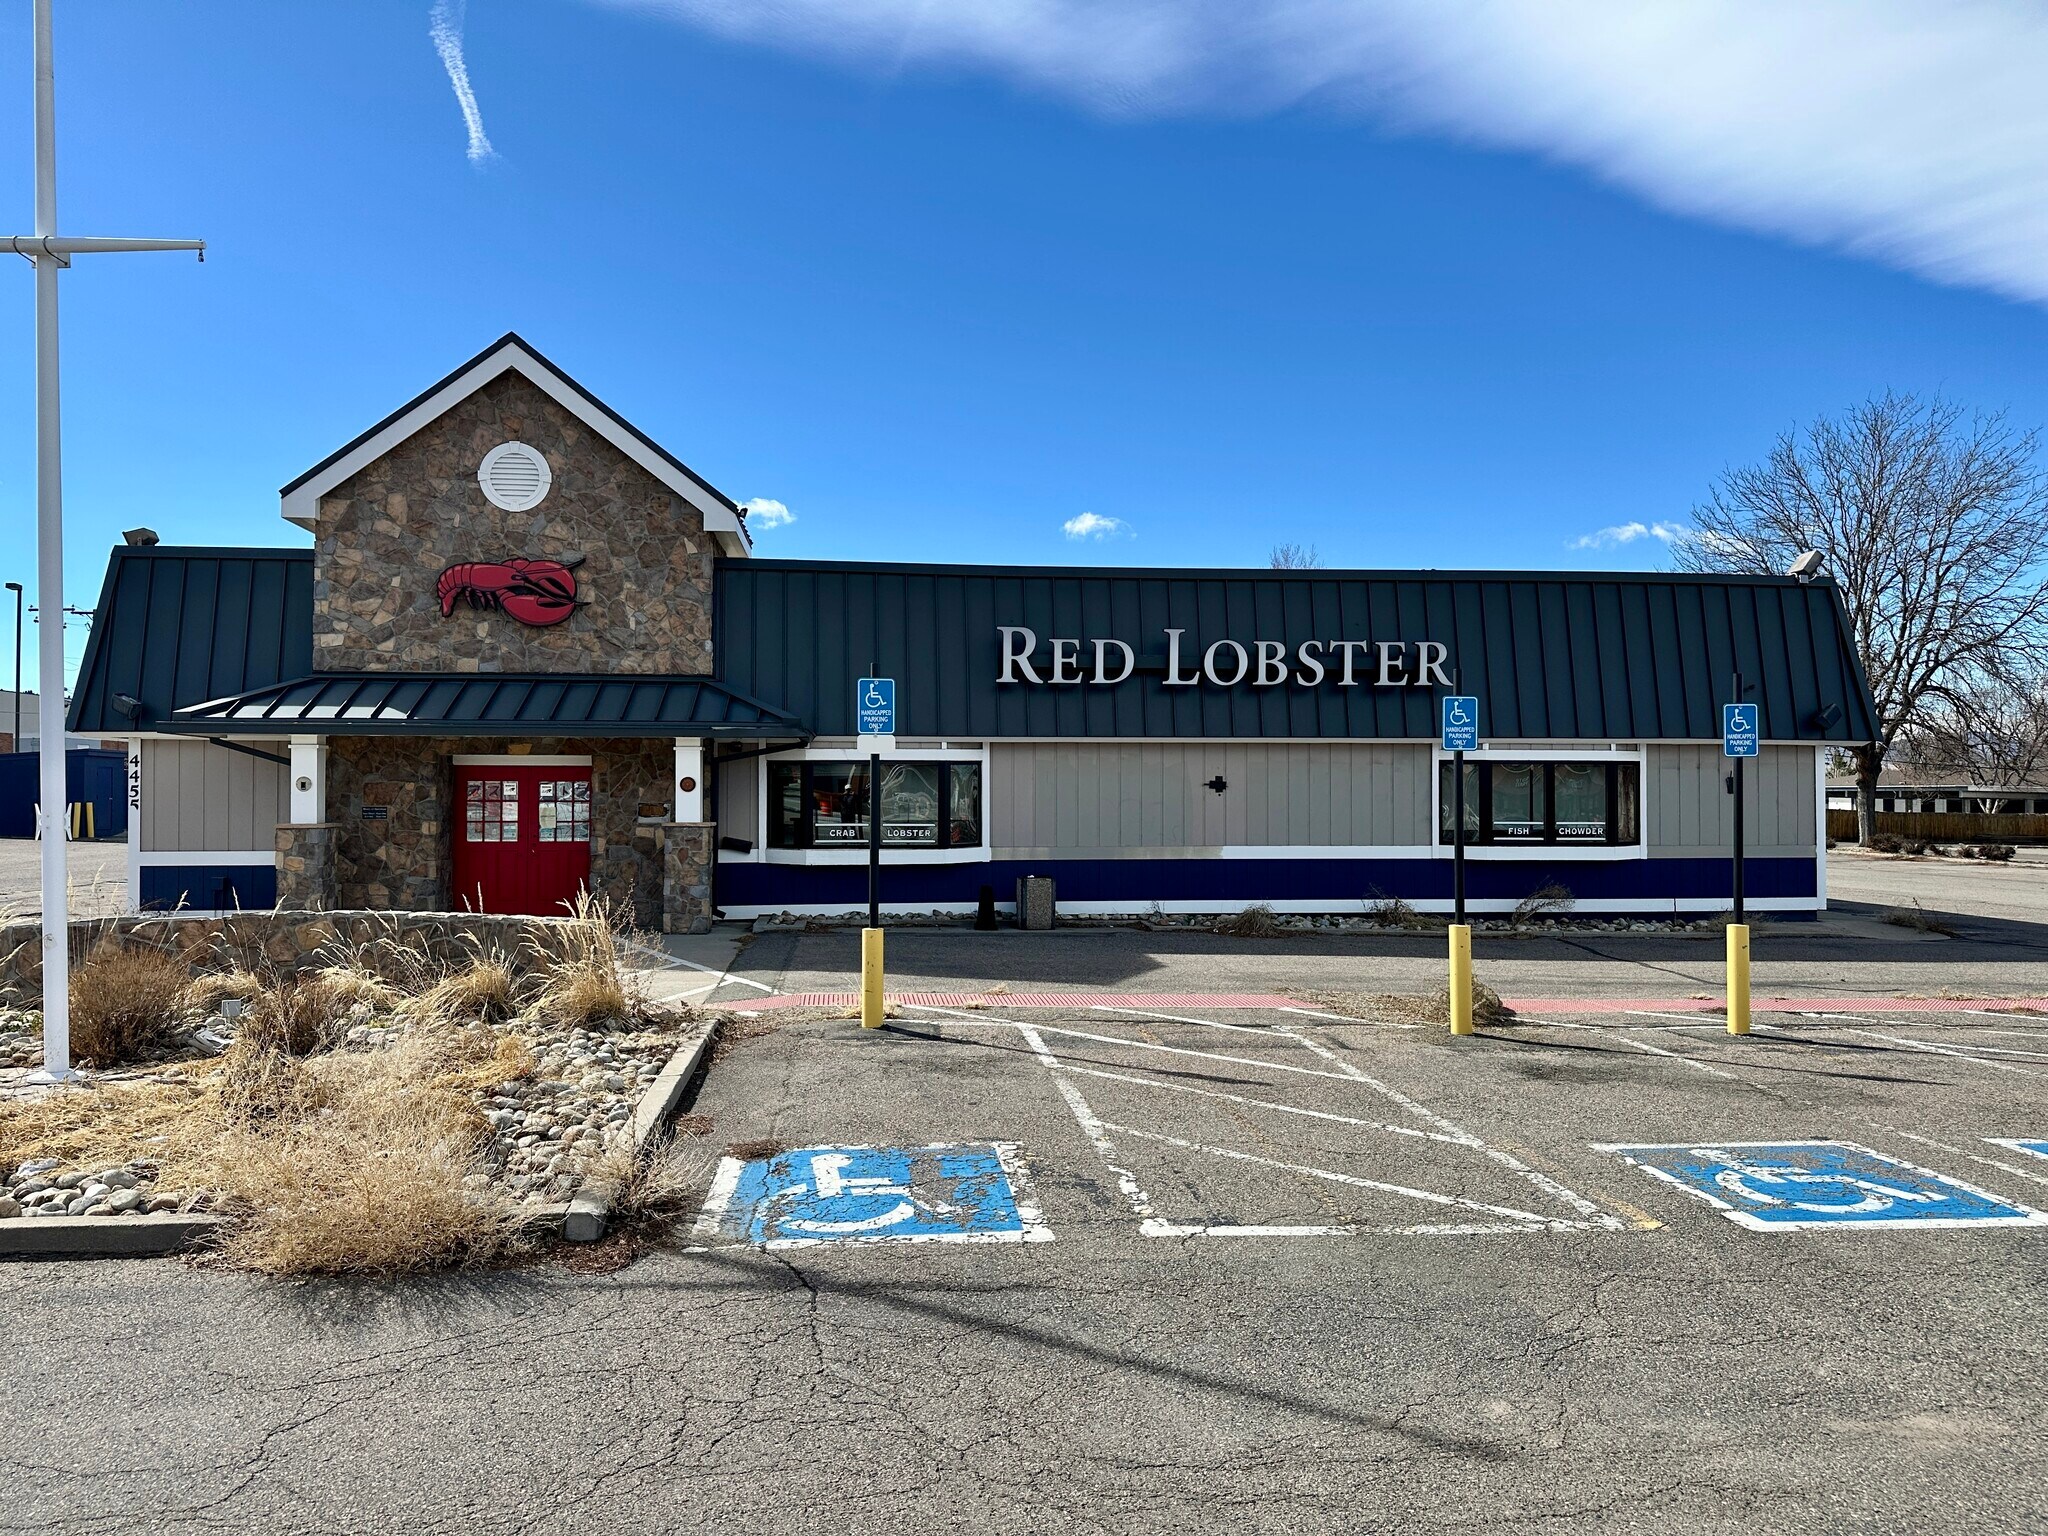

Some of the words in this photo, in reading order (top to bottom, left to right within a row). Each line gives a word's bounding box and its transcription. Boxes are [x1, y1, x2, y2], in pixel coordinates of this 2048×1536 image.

[996, 626, 1135, 684] RED
[1162, 628, 1454, 686] LOBSTER
[829, 829, 856, 837] CRAB
[887, 829, 931, 837] LOBSTER
[1508, 827, 1530, 835] FISH
[1558, 827, 1604, 835] CHOWDER
